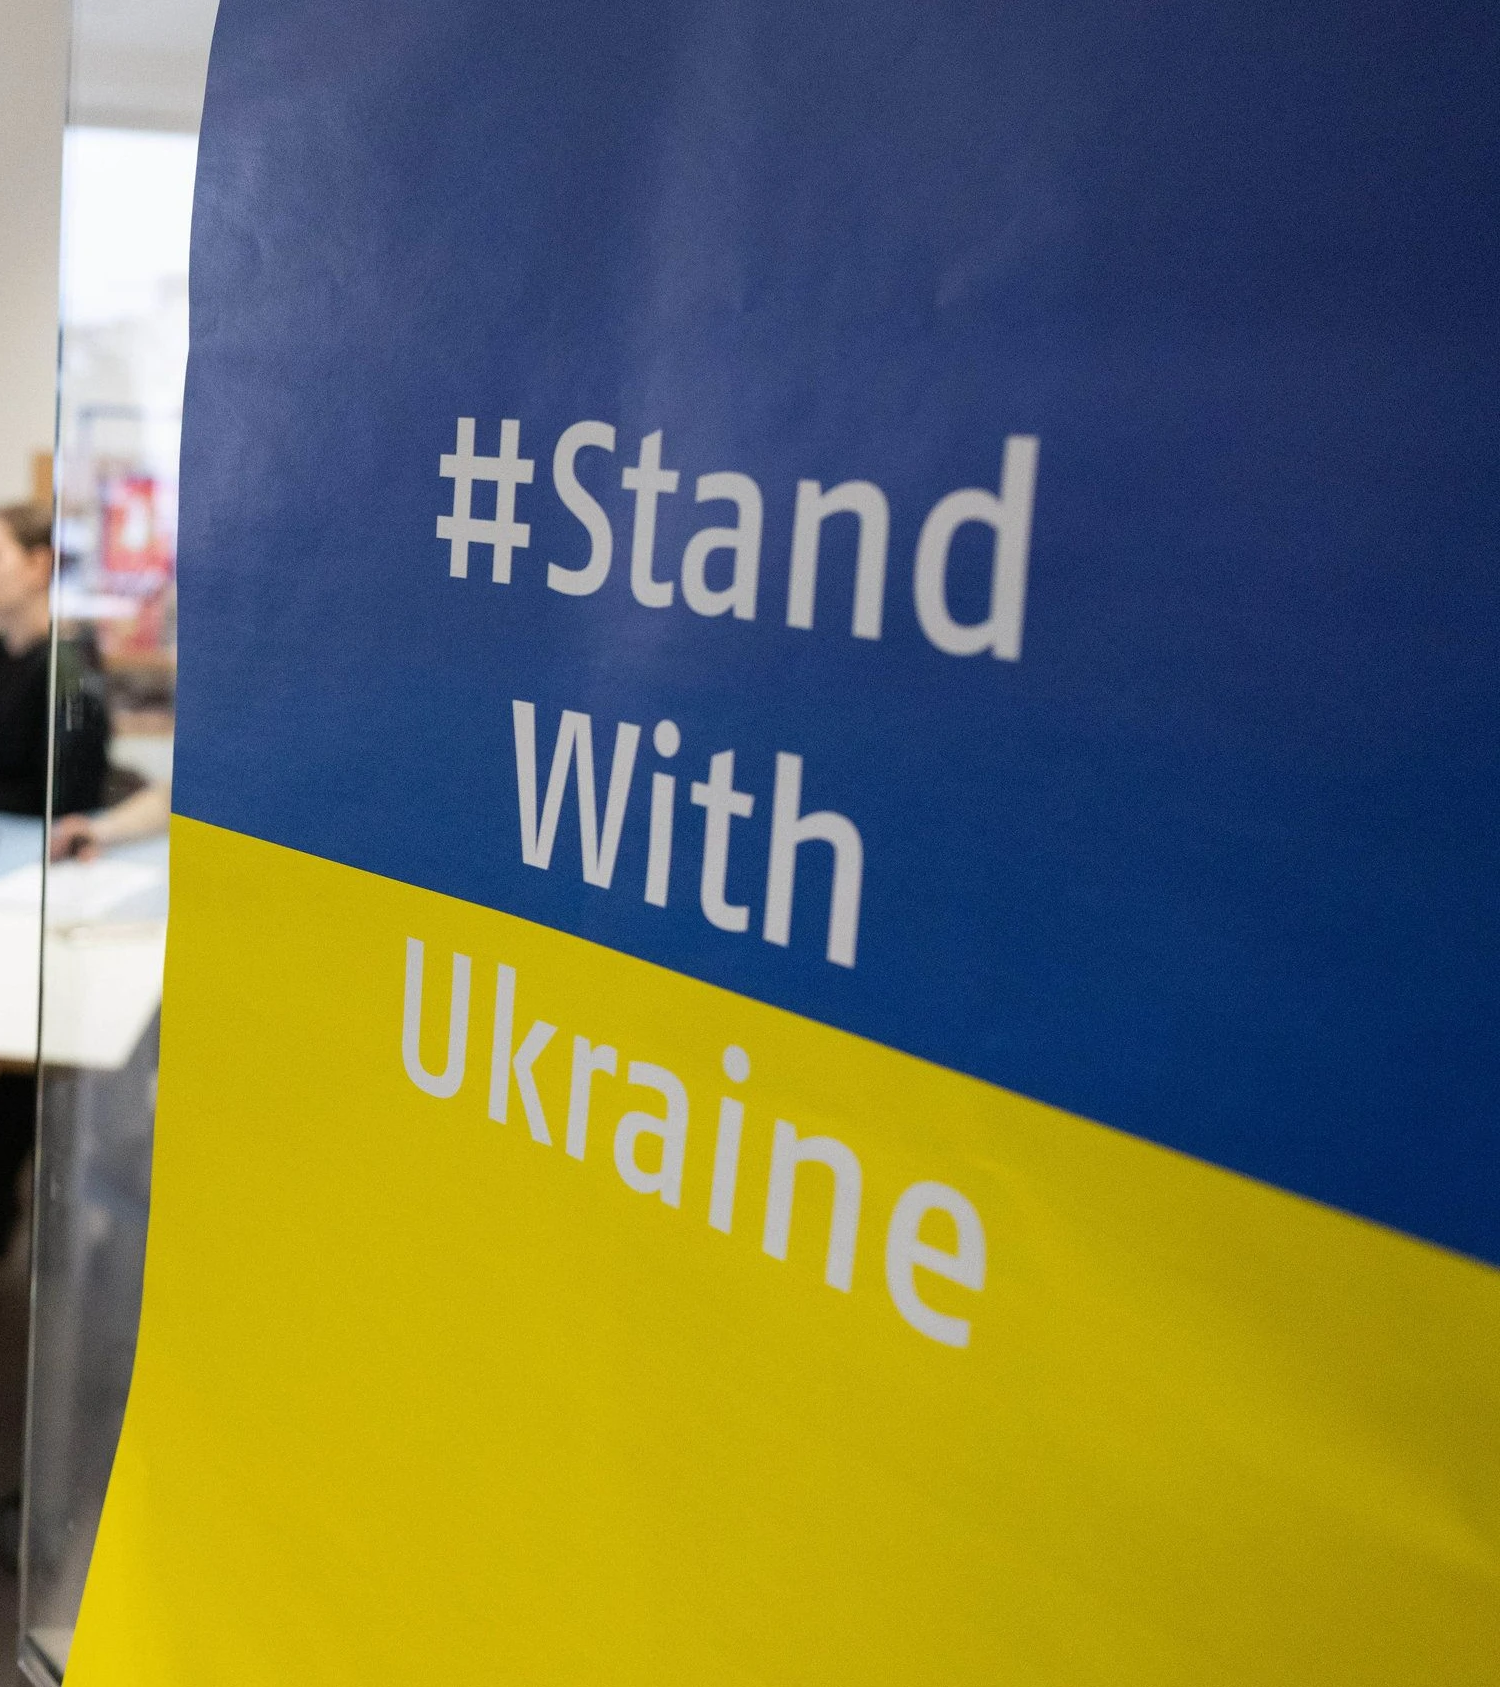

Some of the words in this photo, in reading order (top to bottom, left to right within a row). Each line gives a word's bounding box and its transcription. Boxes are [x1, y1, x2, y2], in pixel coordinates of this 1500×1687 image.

[435, 416, 1039, 661] #Stand
[511, 699, 863, 967] With
[400, 937, 986, 1347] Ukraine
